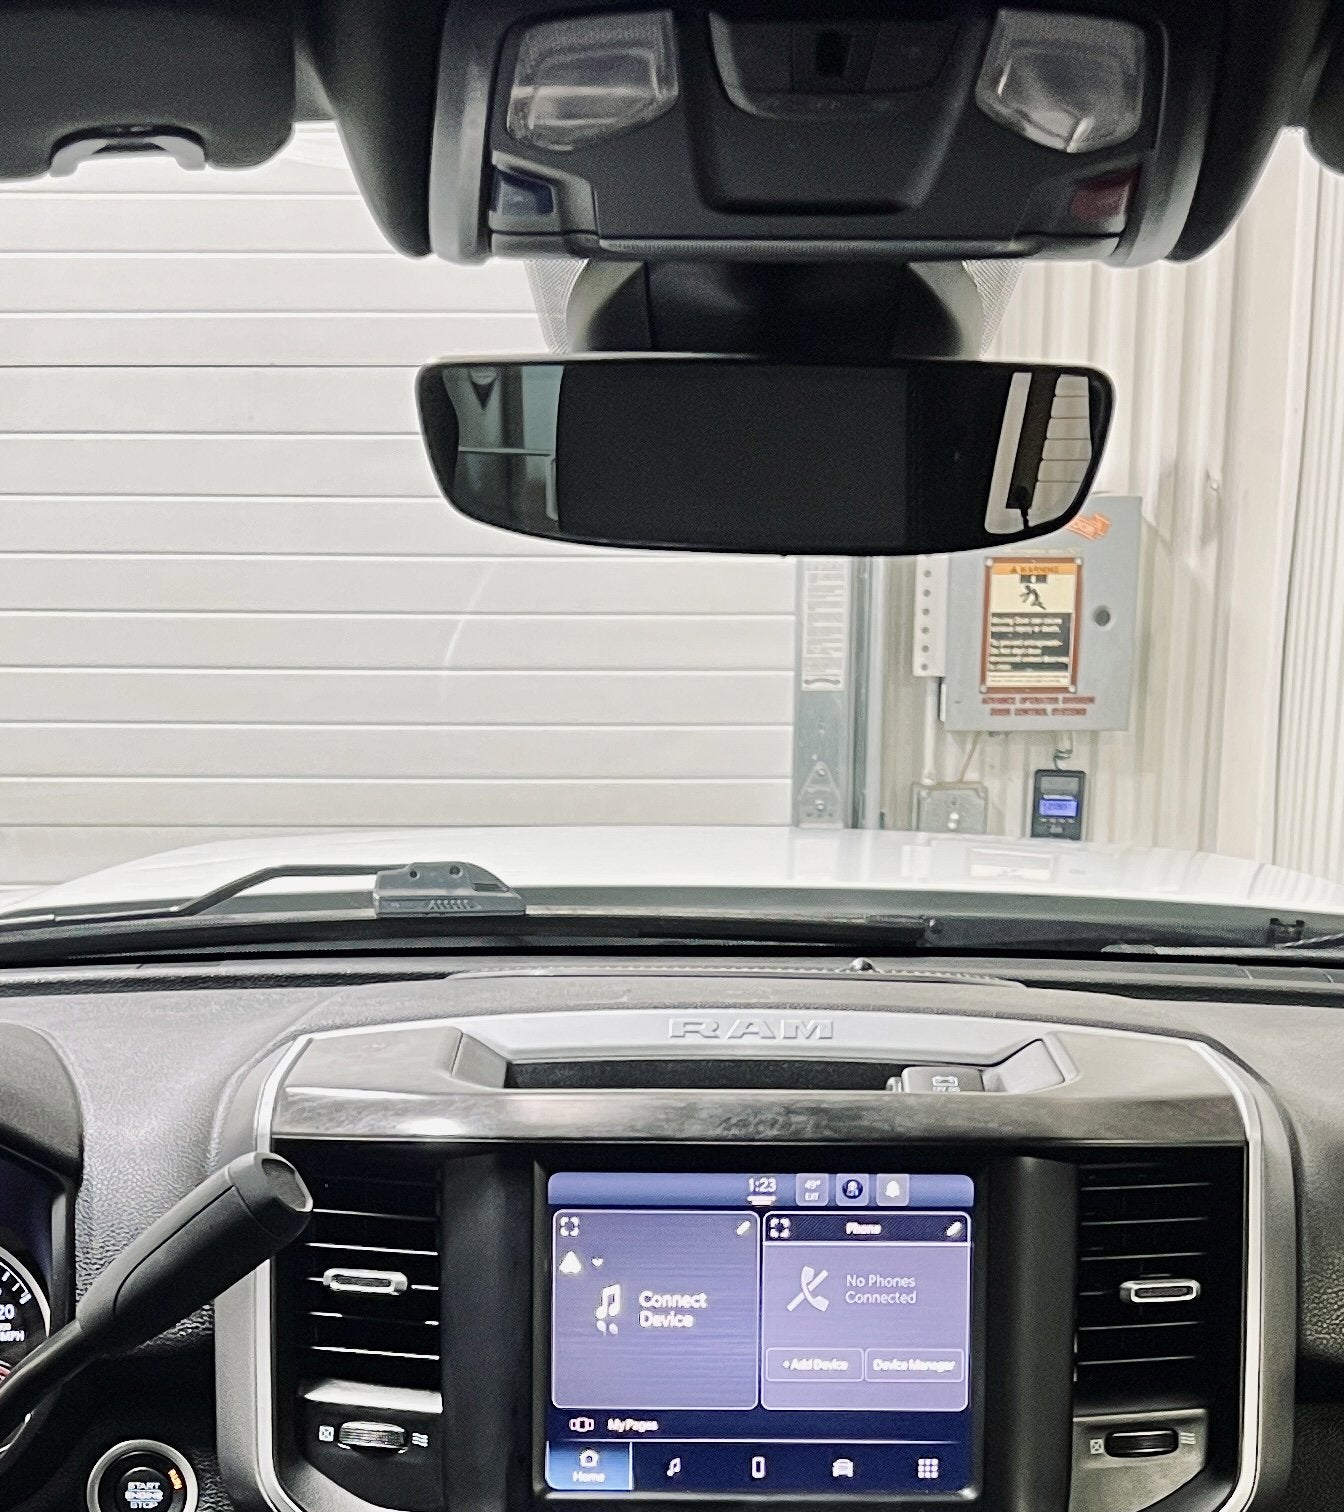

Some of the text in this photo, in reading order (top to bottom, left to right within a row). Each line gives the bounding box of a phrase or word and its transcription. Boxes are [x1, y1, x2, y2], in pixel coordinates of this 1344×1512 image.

[668, 1018, 834, 1040] RAM
[748, 1178, 777, 1193] 1:23
[845, 1221, 882, 1236] Phone
[846, 1274, 916, 1288] No Phones
[638, 1290, 708, 1309] Connect
[845, 1290, 917, 1305] Connected
[638, 1310, 694, 1328] Device
[813, 1358, 849, 1371] Device
[872, 1358, 956, 1373] Device Manager
[572, 1471, 605, 1483] Home
[127, 1482, 161, 1491] START
[129, 1501, 159, 1510] STOP
